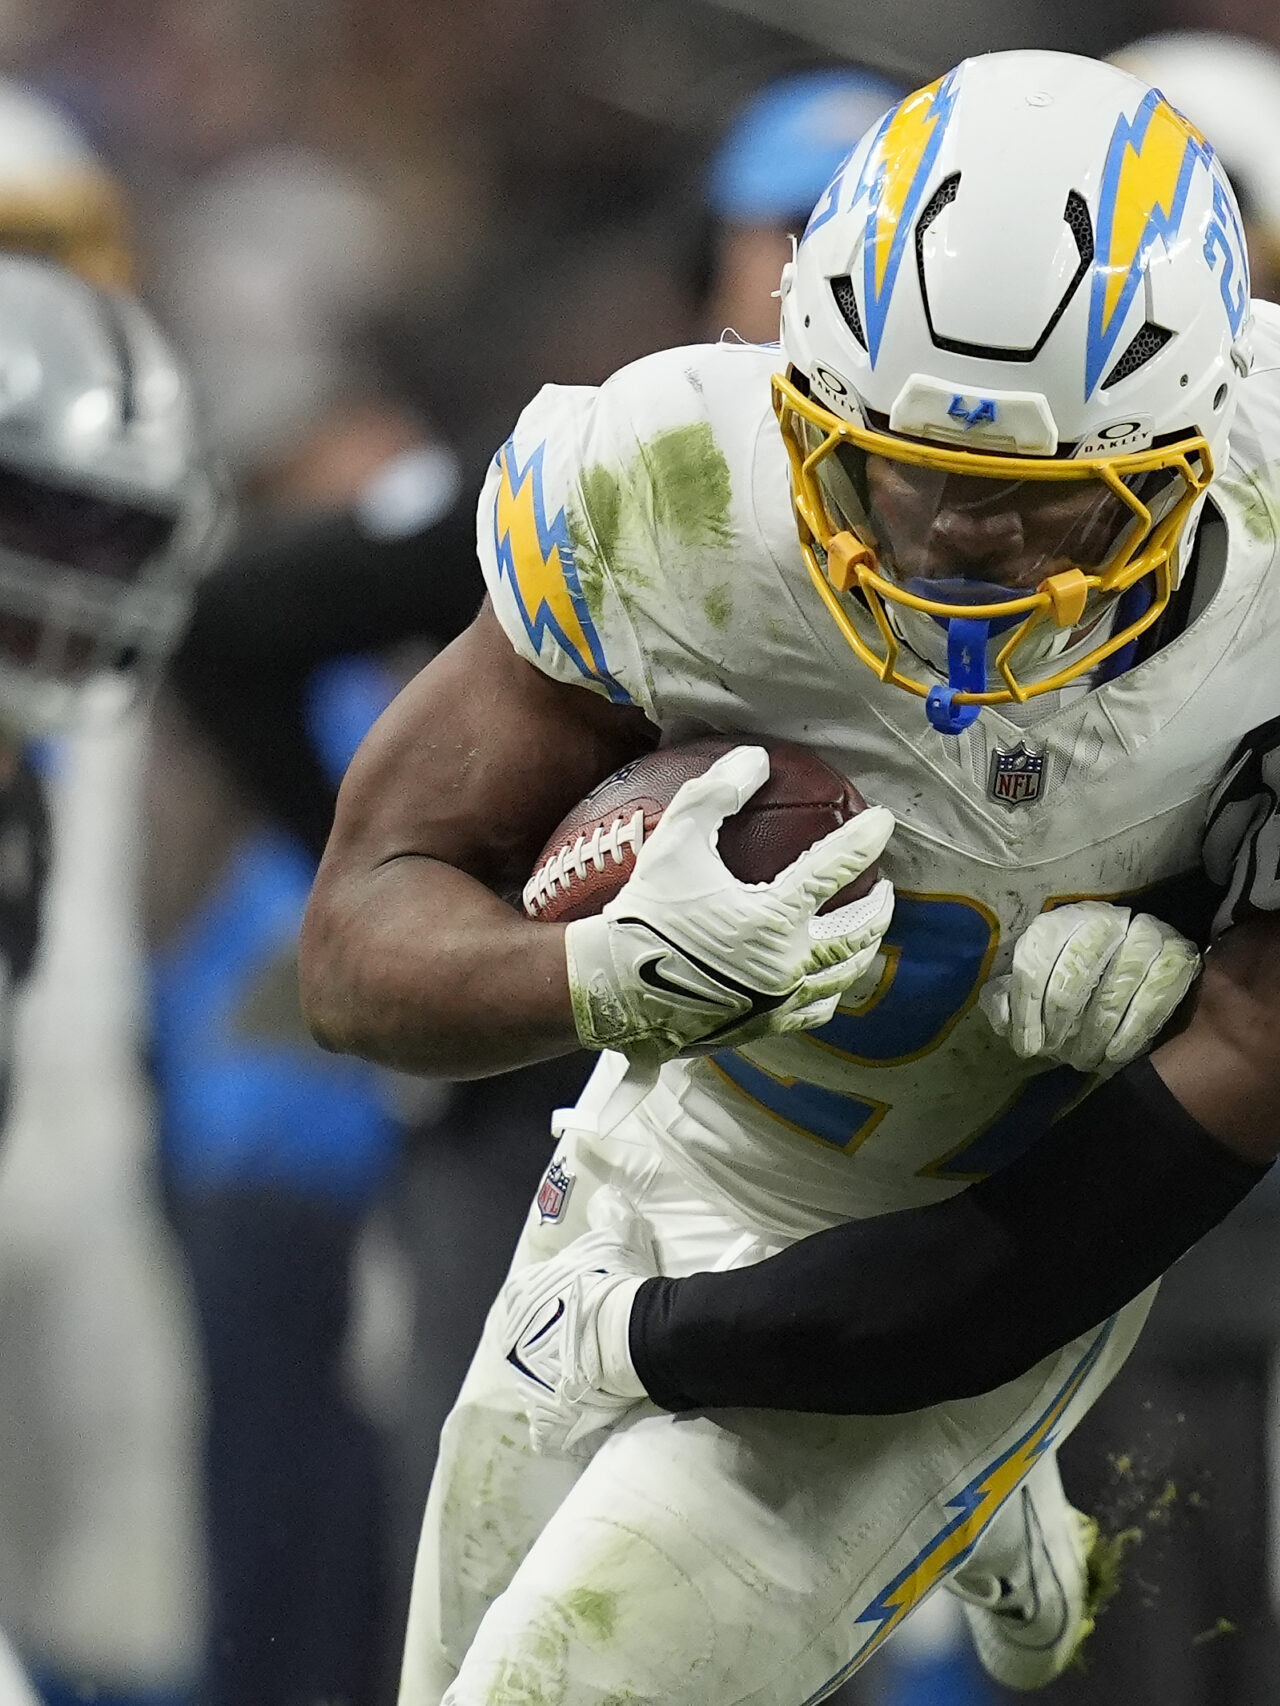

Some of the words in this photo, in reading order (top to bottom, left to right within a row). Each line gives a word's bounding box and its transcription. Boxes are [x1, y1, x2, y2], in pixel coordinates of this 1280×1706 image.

[947, 393, 996, 430] LA
[1085, 431, 1149, 453] OAKLEY
[997, 774, 1036, 799] NFL
